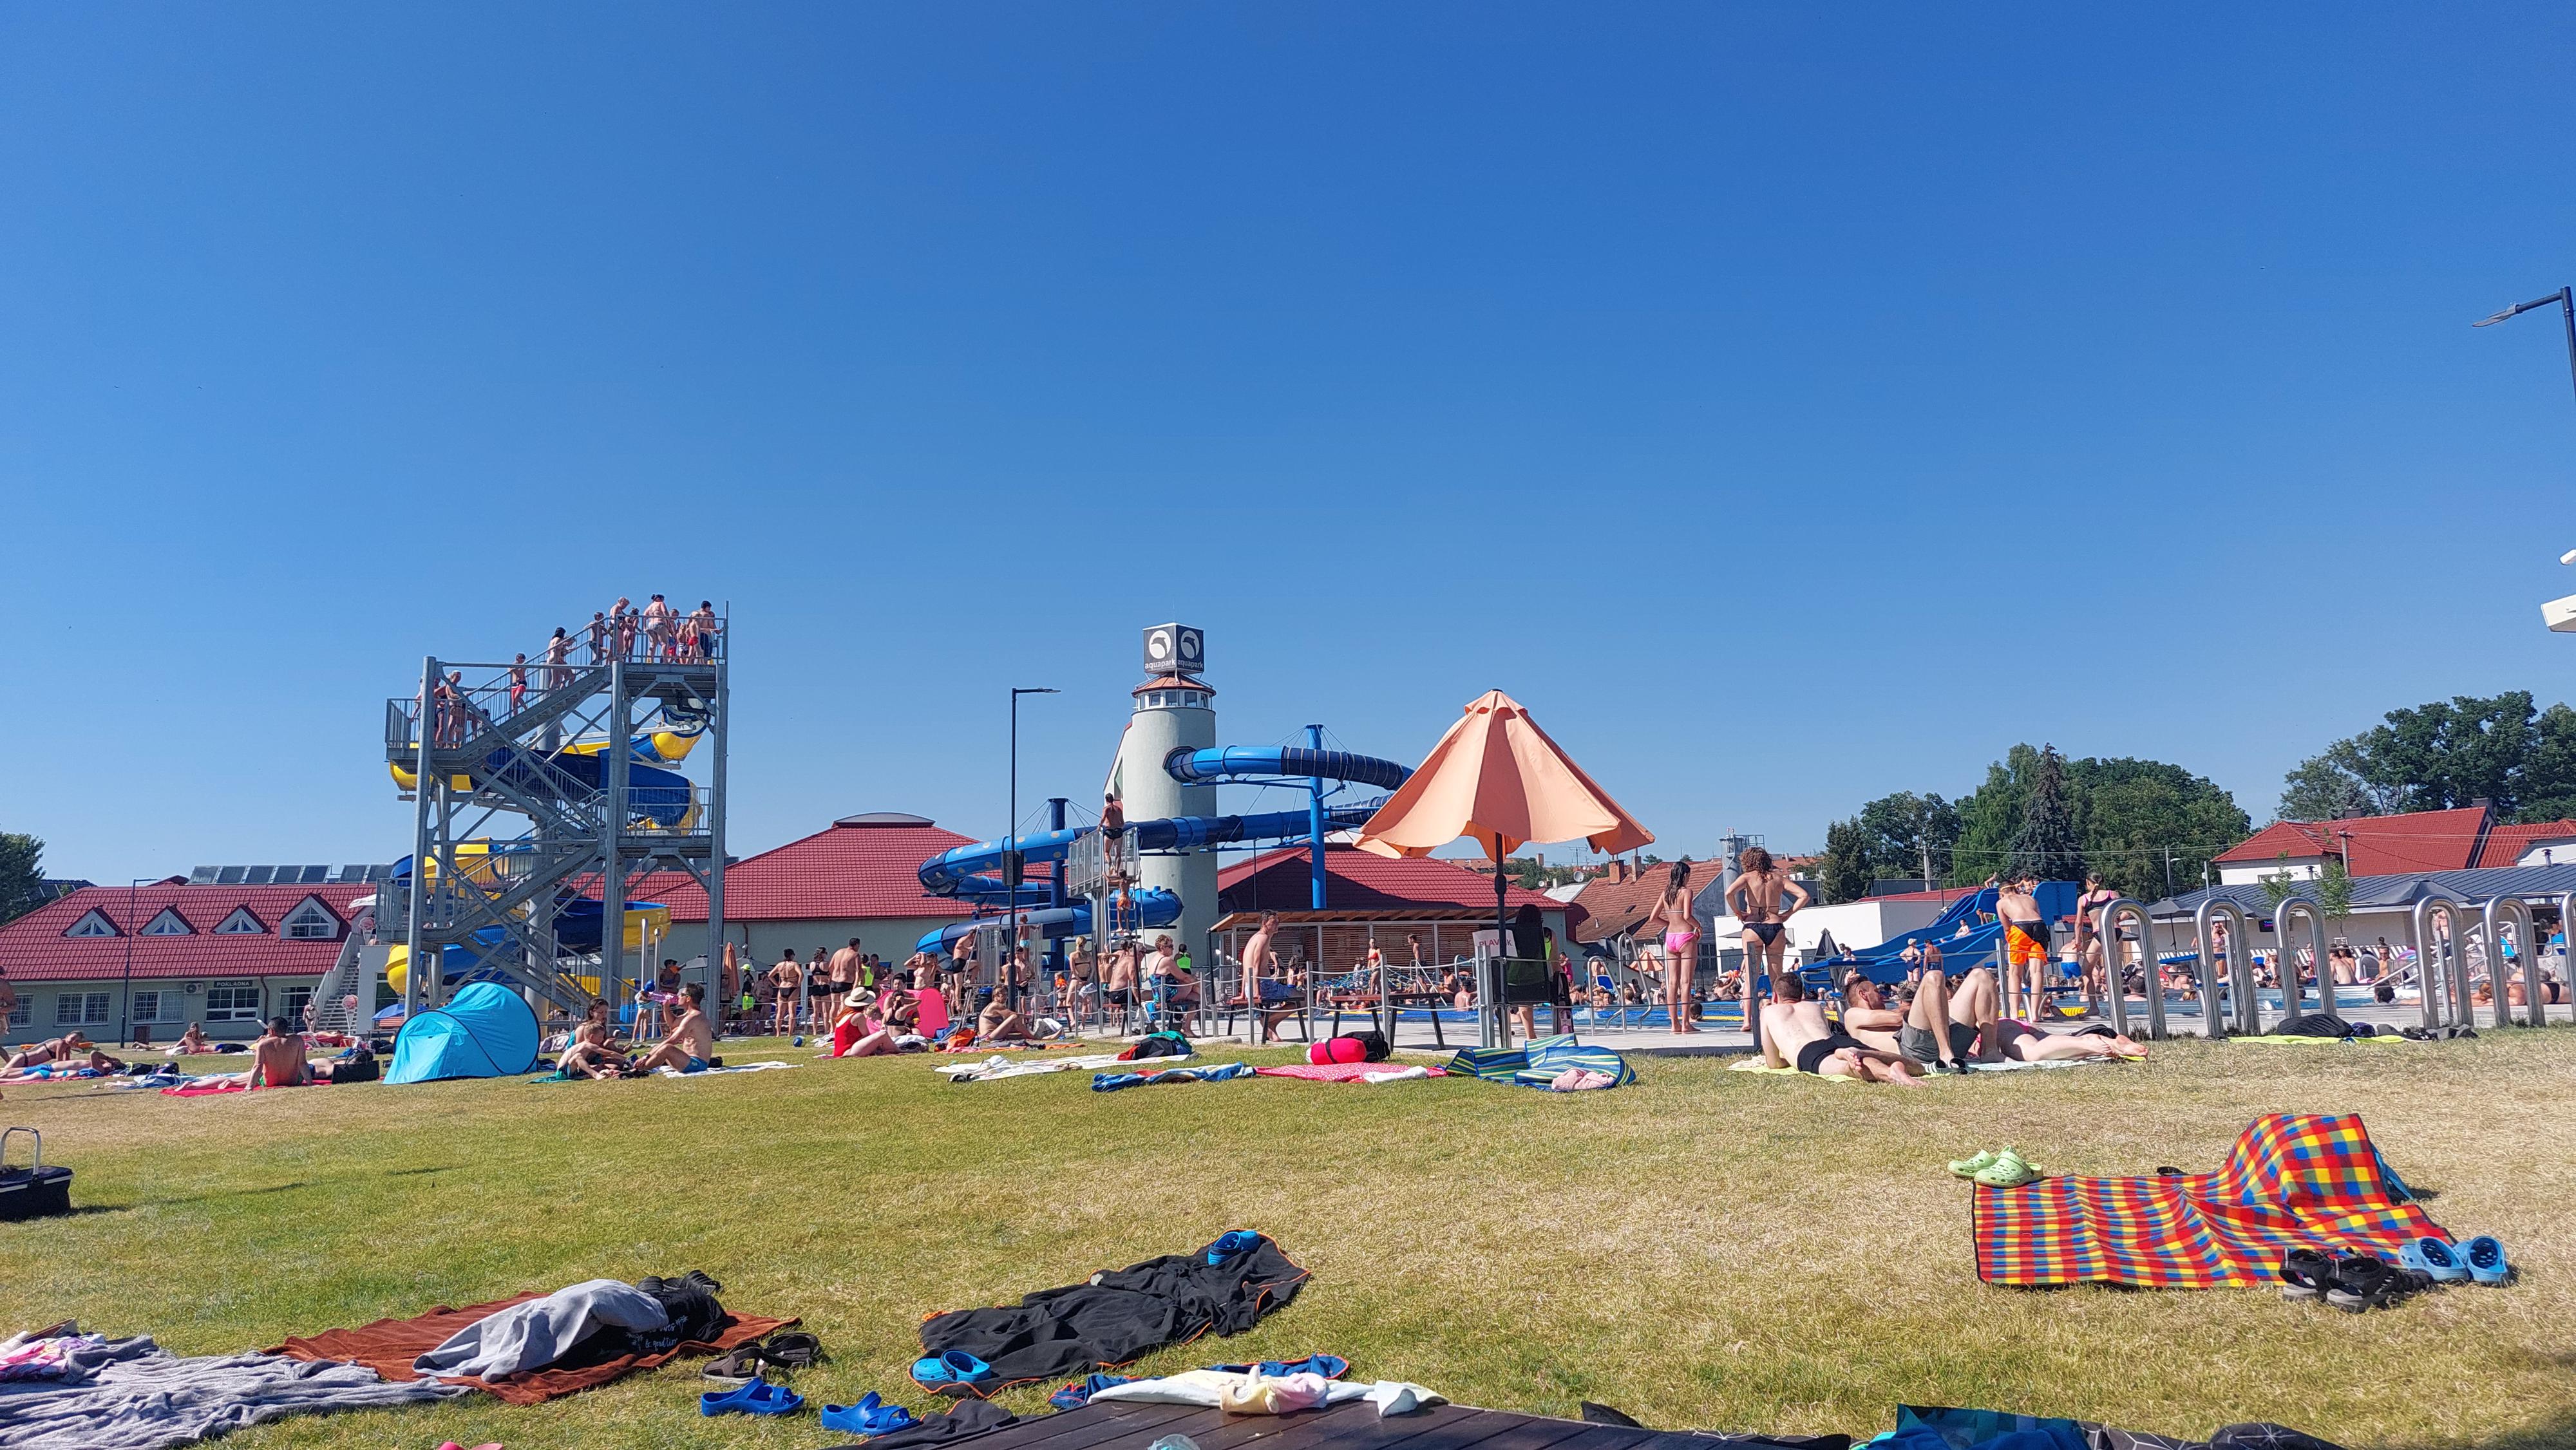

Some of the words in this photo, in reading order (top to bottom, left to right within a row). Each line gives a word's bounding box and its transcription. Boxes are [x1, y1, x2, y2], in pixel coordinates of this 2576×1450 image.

[1144, 658, 1176, 670] aquapark
[1177, 659, 1204, 669] aquapark
[1479, 939, 1513, 947] PLAVK
